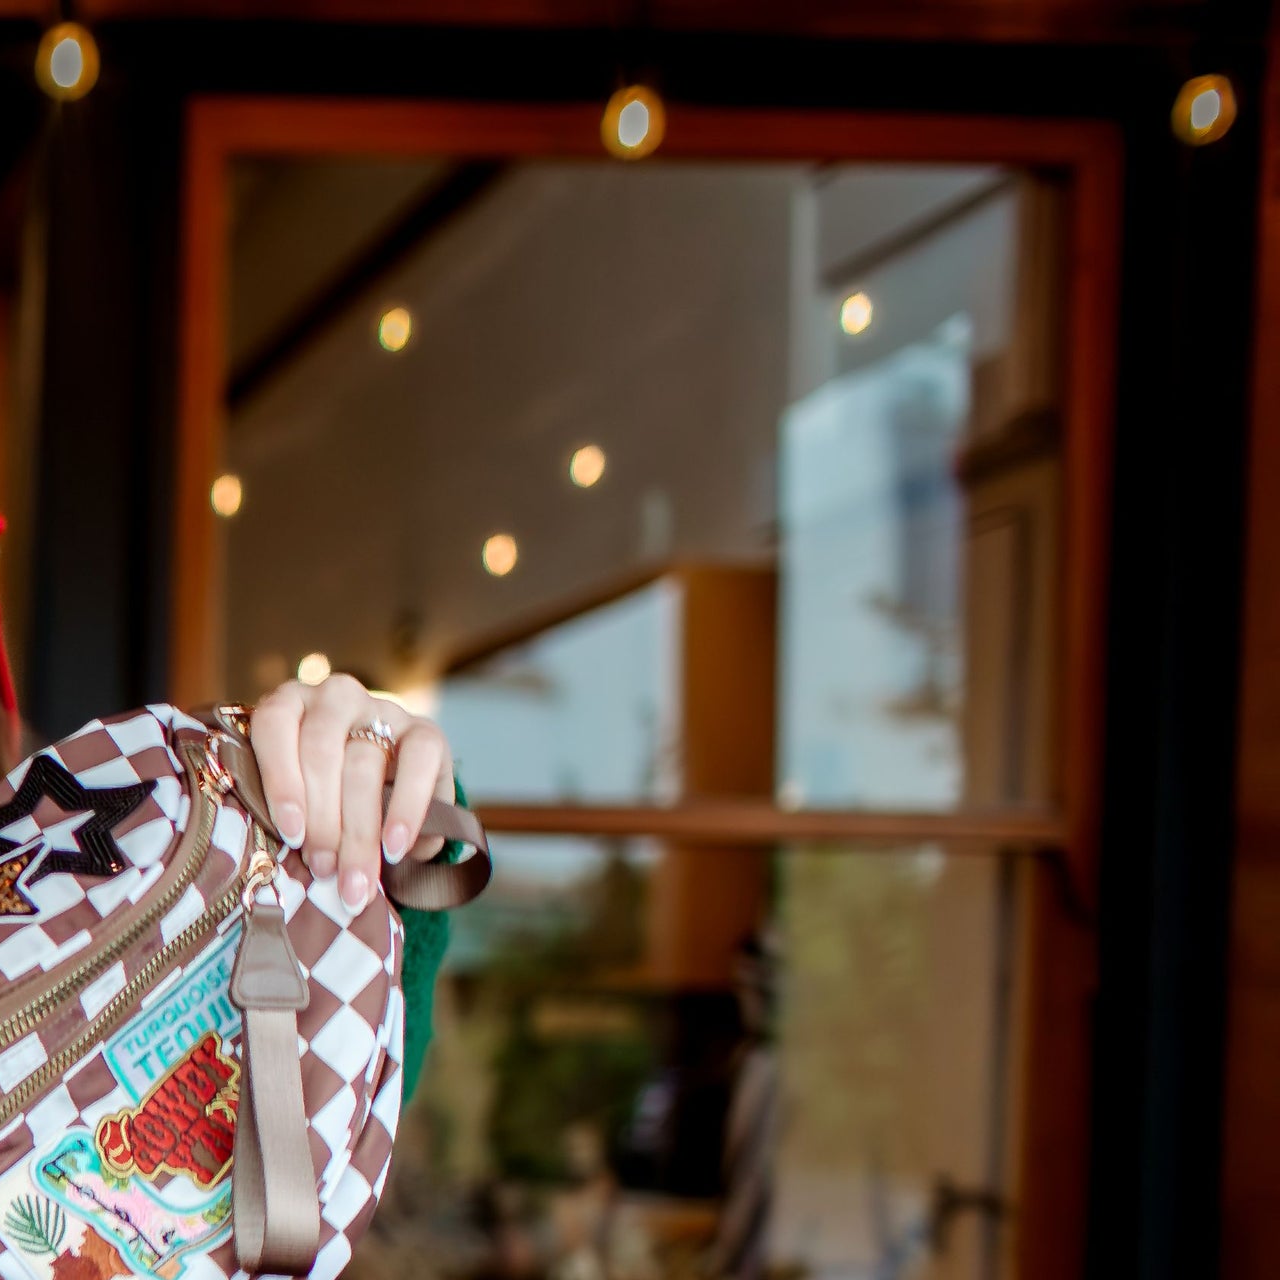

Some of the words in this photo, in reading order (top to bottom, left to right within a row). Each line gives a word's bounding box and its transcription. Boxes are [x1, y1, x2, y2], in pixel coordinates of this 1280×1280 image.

[123, 957, 231, 1056] TURQUOISE
[133, 996, 233, 1080] TEQUI
[131, 1036, 235, 1174] HOWDY
